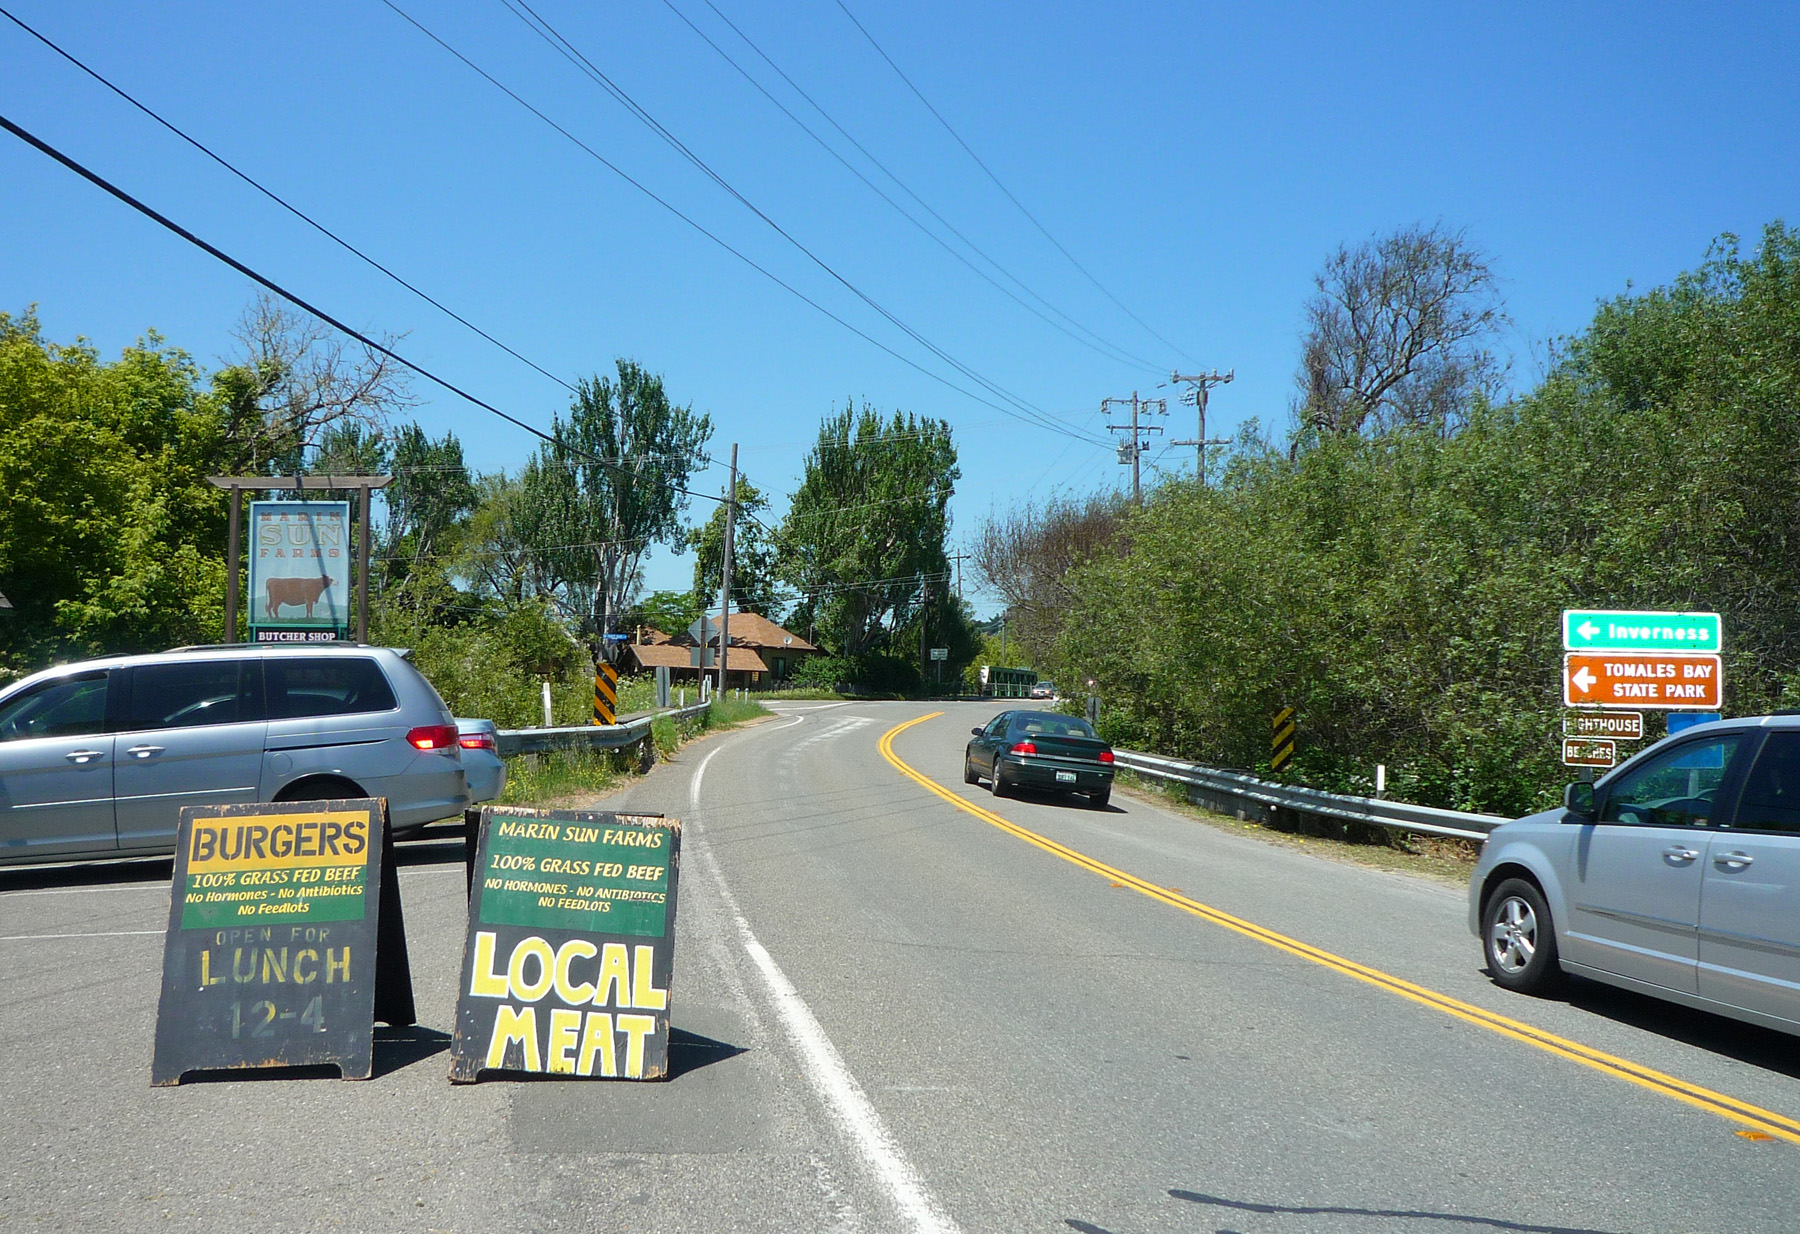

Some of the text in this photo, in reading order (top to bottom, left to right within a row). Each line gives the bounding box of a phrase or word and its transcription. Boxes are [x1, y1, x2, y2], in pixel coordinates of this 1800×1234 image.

[260, 512, 340, 521] MARIN
[260, 524, 341, 546] SUN
[260, 548, 340, 558] FARMS
[258, 632, 336, 641] BUTCHER SHOP
[1609, 623, 1710, 641] Inverness
[1604, 663, 1713, 678] TOMALES BAY
[1613, 683, 1706, 698] STATE PARK
[191, 821, 366, 862] BURGERS
[499, 822, 663, 848] MARIN SUN FARMS
[192, 866, 361, 888] 100% GRASS FED BEEF
[490, 854, 665, 881] 100% GRASS FED BEEF
[185, 893, 203, 903] No
[206, 890, 268, 902] Hormones
[278, 887, 295, 899] No
[296, 885, 363, 898] Antibiotics
[484, 878, 503, 889] NO
[504, 879, 568, 895] HORMONES
[576, 886, 594, 897] NO
[595, 888, 666, 904] ANTIBIOTICS
[238, 902, 310, 916] No Feedlots
[538, 896, 611, 913] NO FEEDLOTS
[216, 926, 331, 945] OPEN FOR
[201, 946, 351, 986] LUNCH
[469, 931, 667, 1011] LOCAL
[230, 994, 325, 1039] 12-4
[486, 1005, 655, 1079] MEAT
